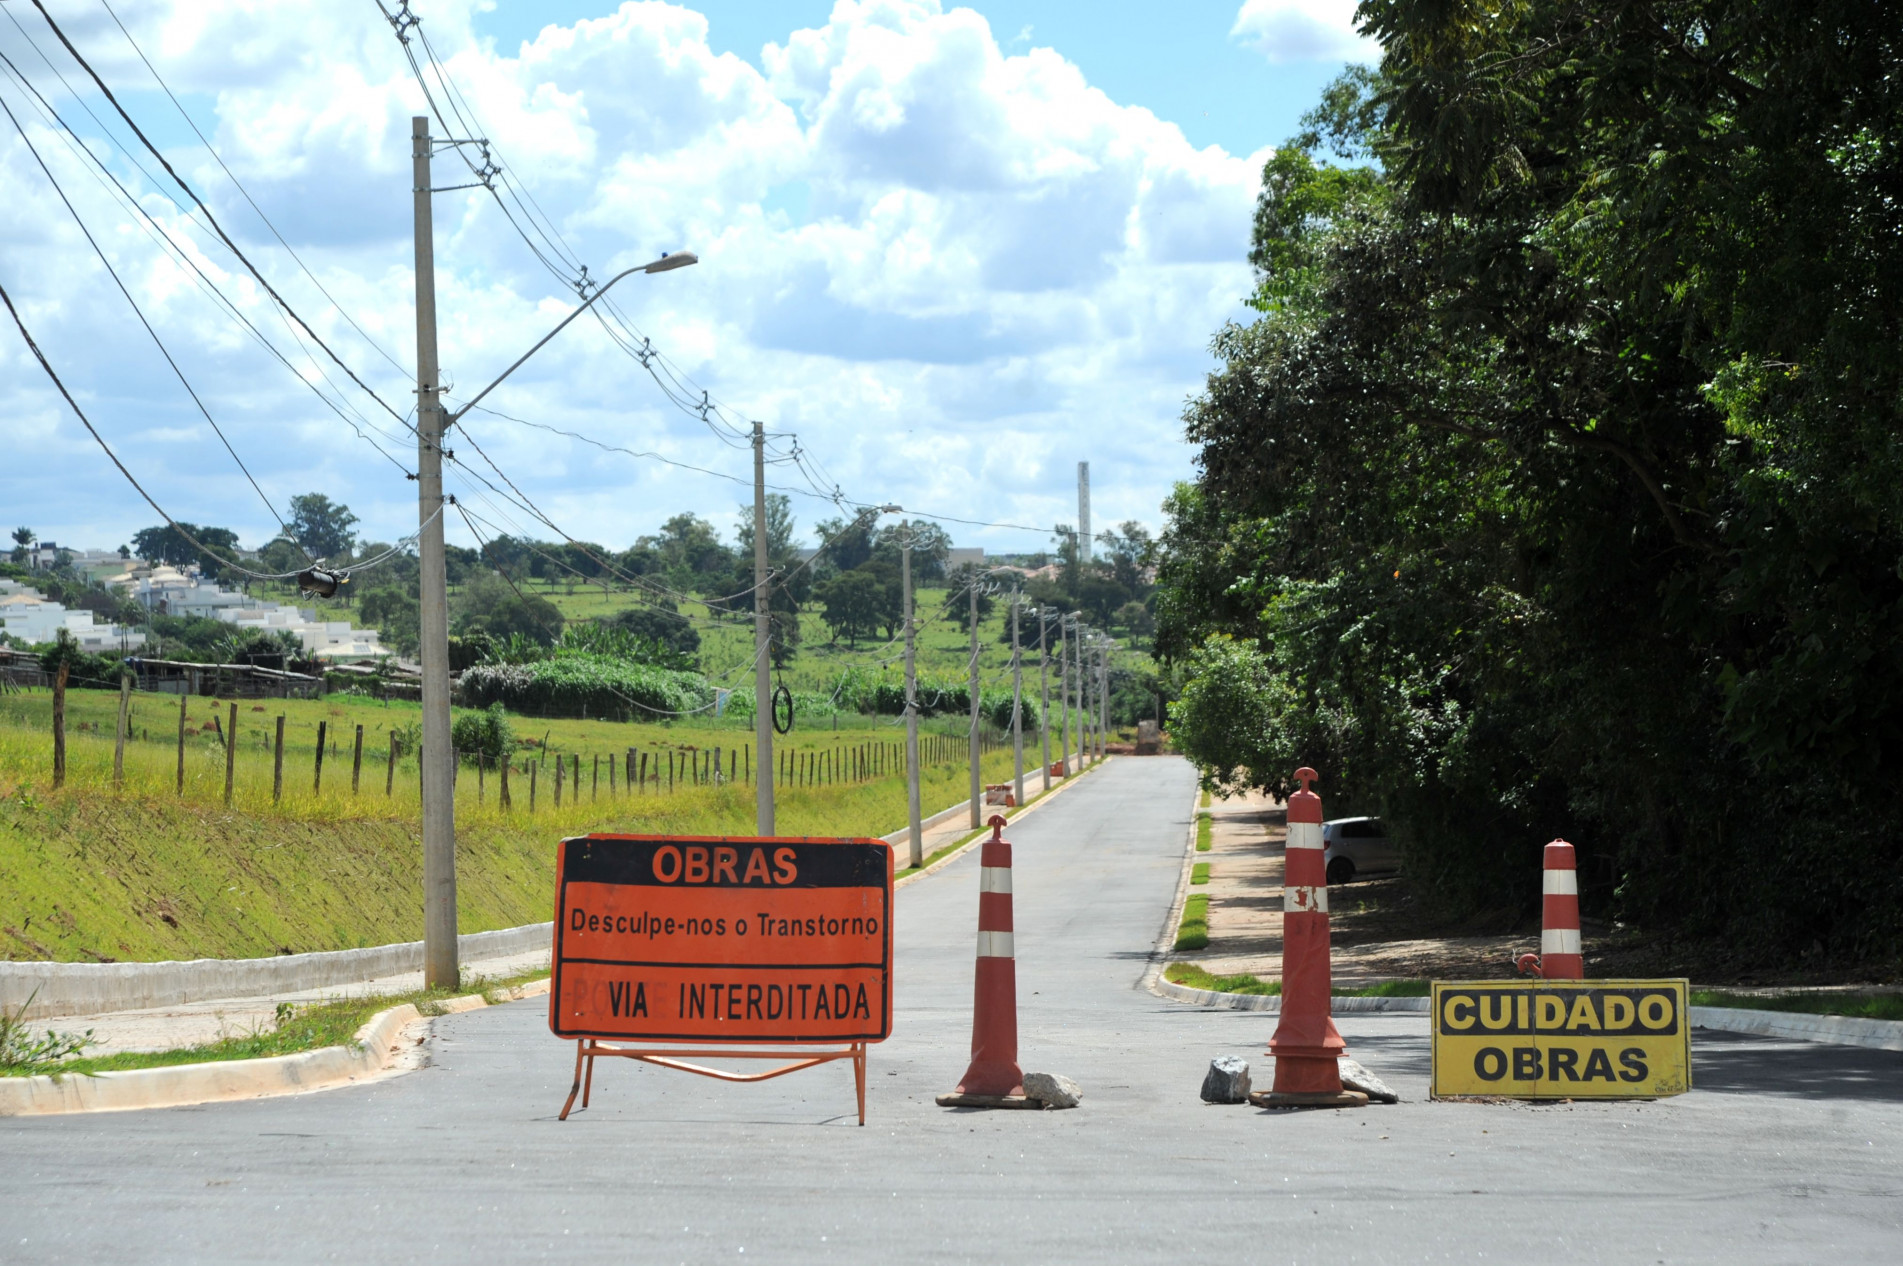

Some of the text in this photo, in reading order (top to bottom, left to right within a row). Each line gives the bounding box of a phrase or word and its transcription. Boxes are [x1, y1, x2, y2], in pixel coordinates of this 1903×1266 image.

[652, 845, 798, 885] OBRAS
[571, 908, 878, 940] Desculpe-nos o Transtorno
[608, 980, 871, 1020] VIA INTERDITADA
[1443, 994, 1674, 1031] CUIDADO
[1473, 1047, 1649, 1083] OBRAS
